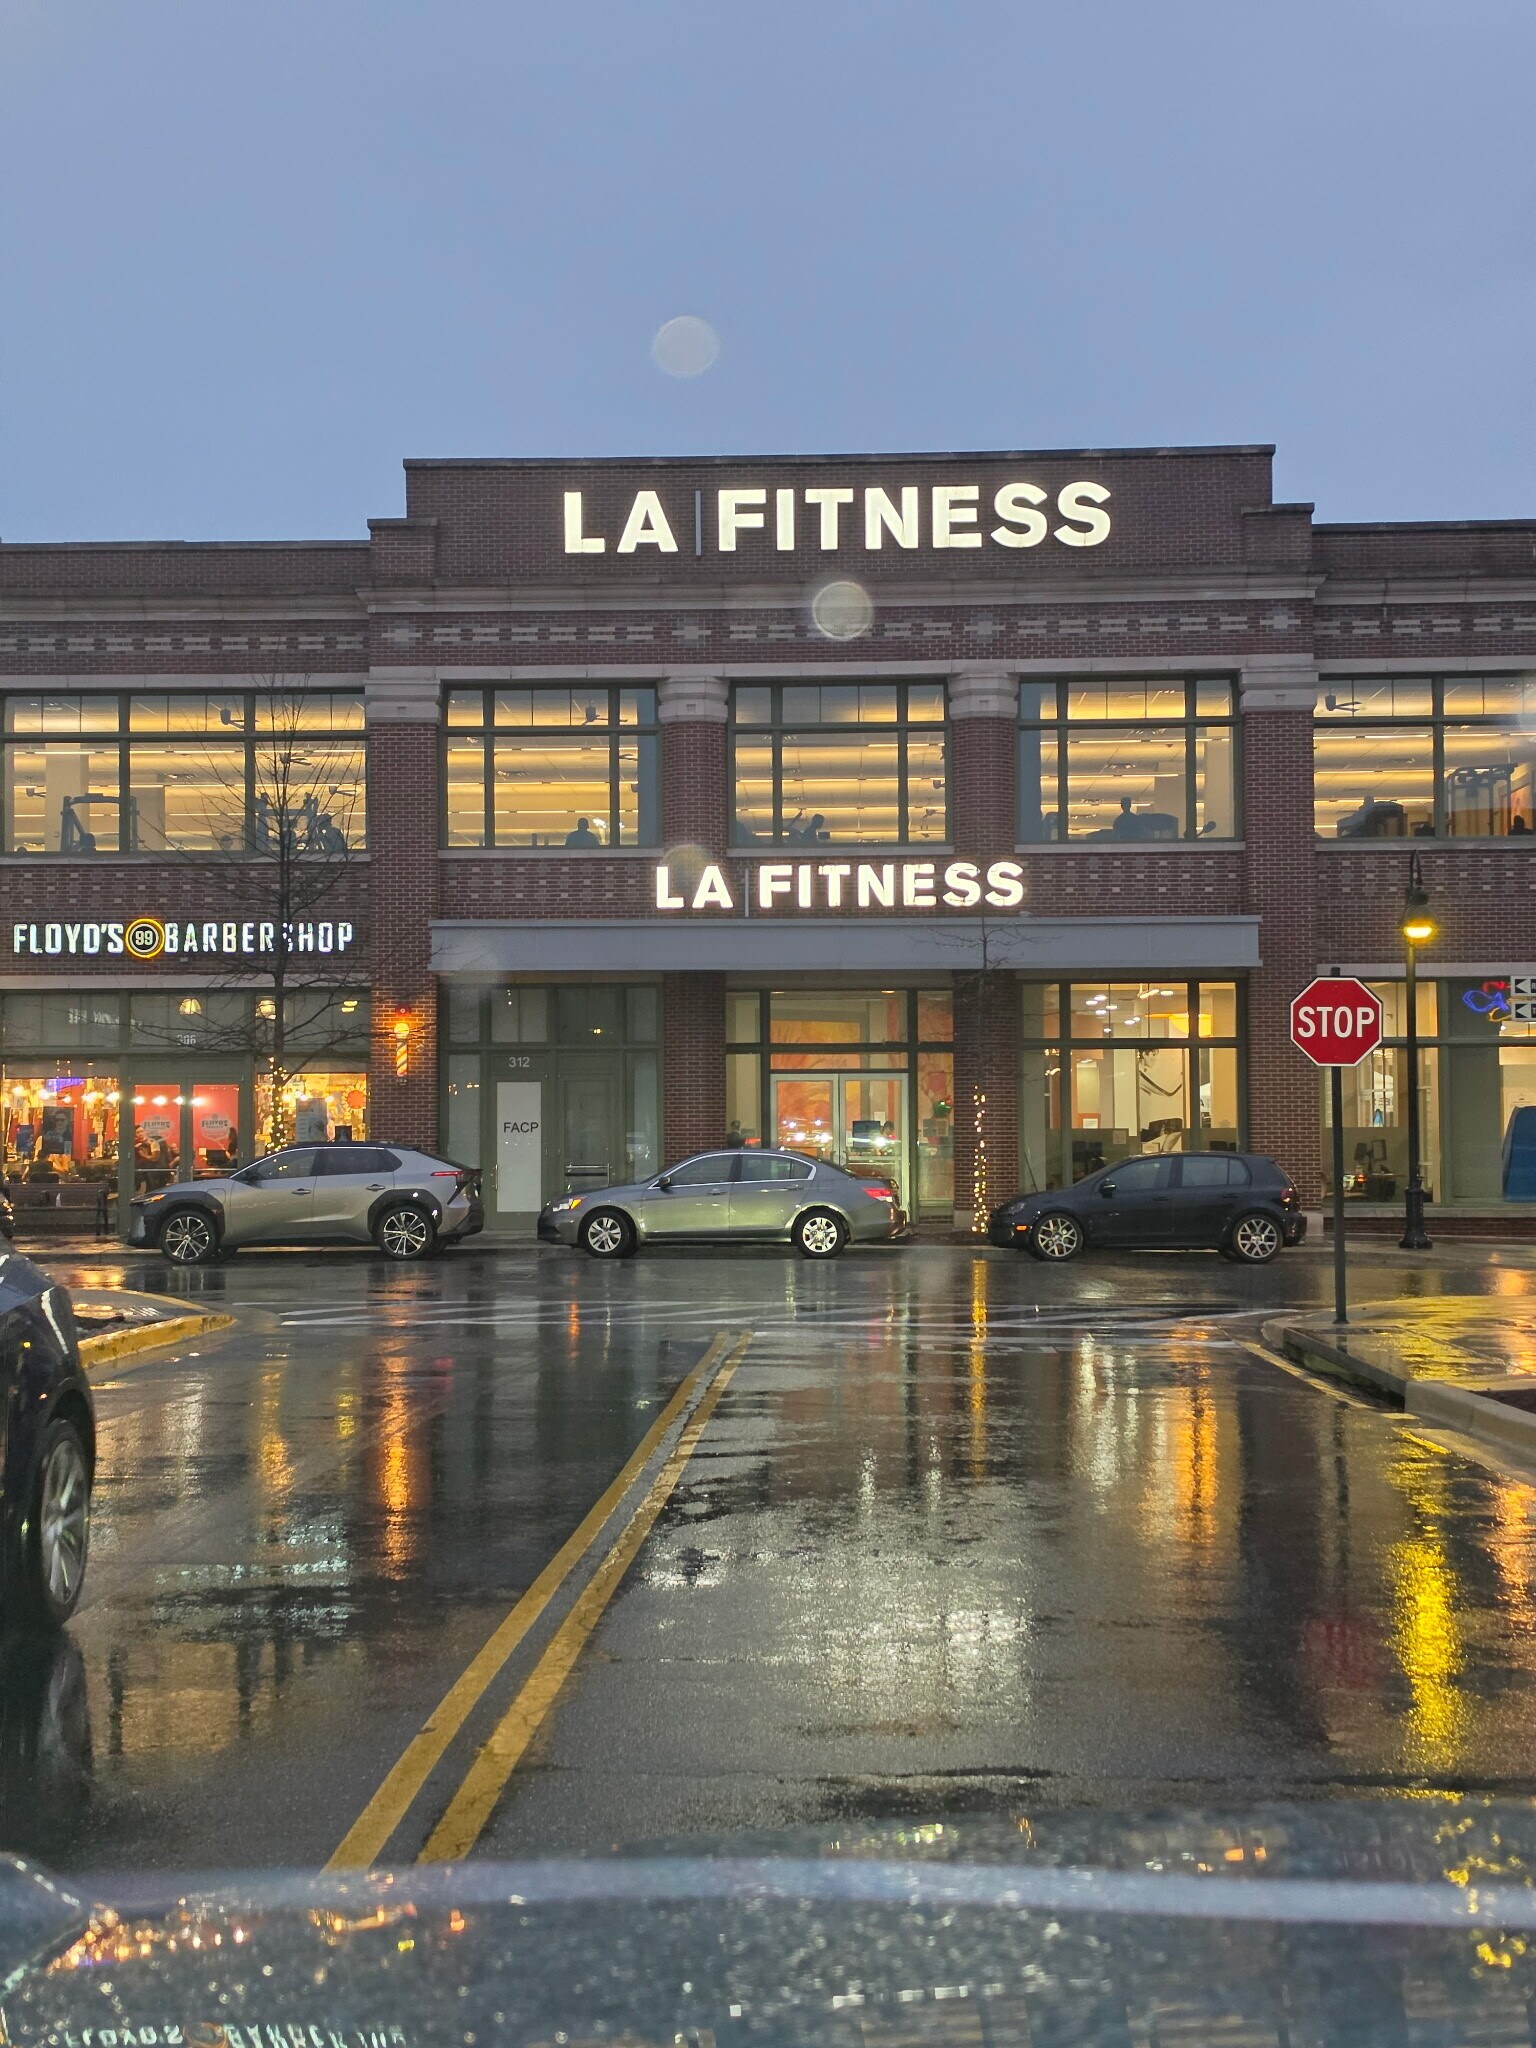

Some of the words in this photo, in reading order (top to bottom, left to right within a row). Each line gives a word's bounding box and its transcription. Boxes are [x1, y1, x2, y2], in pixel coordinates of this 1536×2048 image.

[563, 490, 679, 554] LA
[718, 481, 1112, 552] FITNESS
[656, 865, 734, 909] LA
[759, 861, 1024, 908] FITNESS
[13, 923, 124, 954] FLOYD'S
[135, 930, 153, 946] 99
[1297, 1006, 1375, 1038] STOP
[508, 1056, 530, 1068] 312
[503, 1122, 539, 1133] FACP
